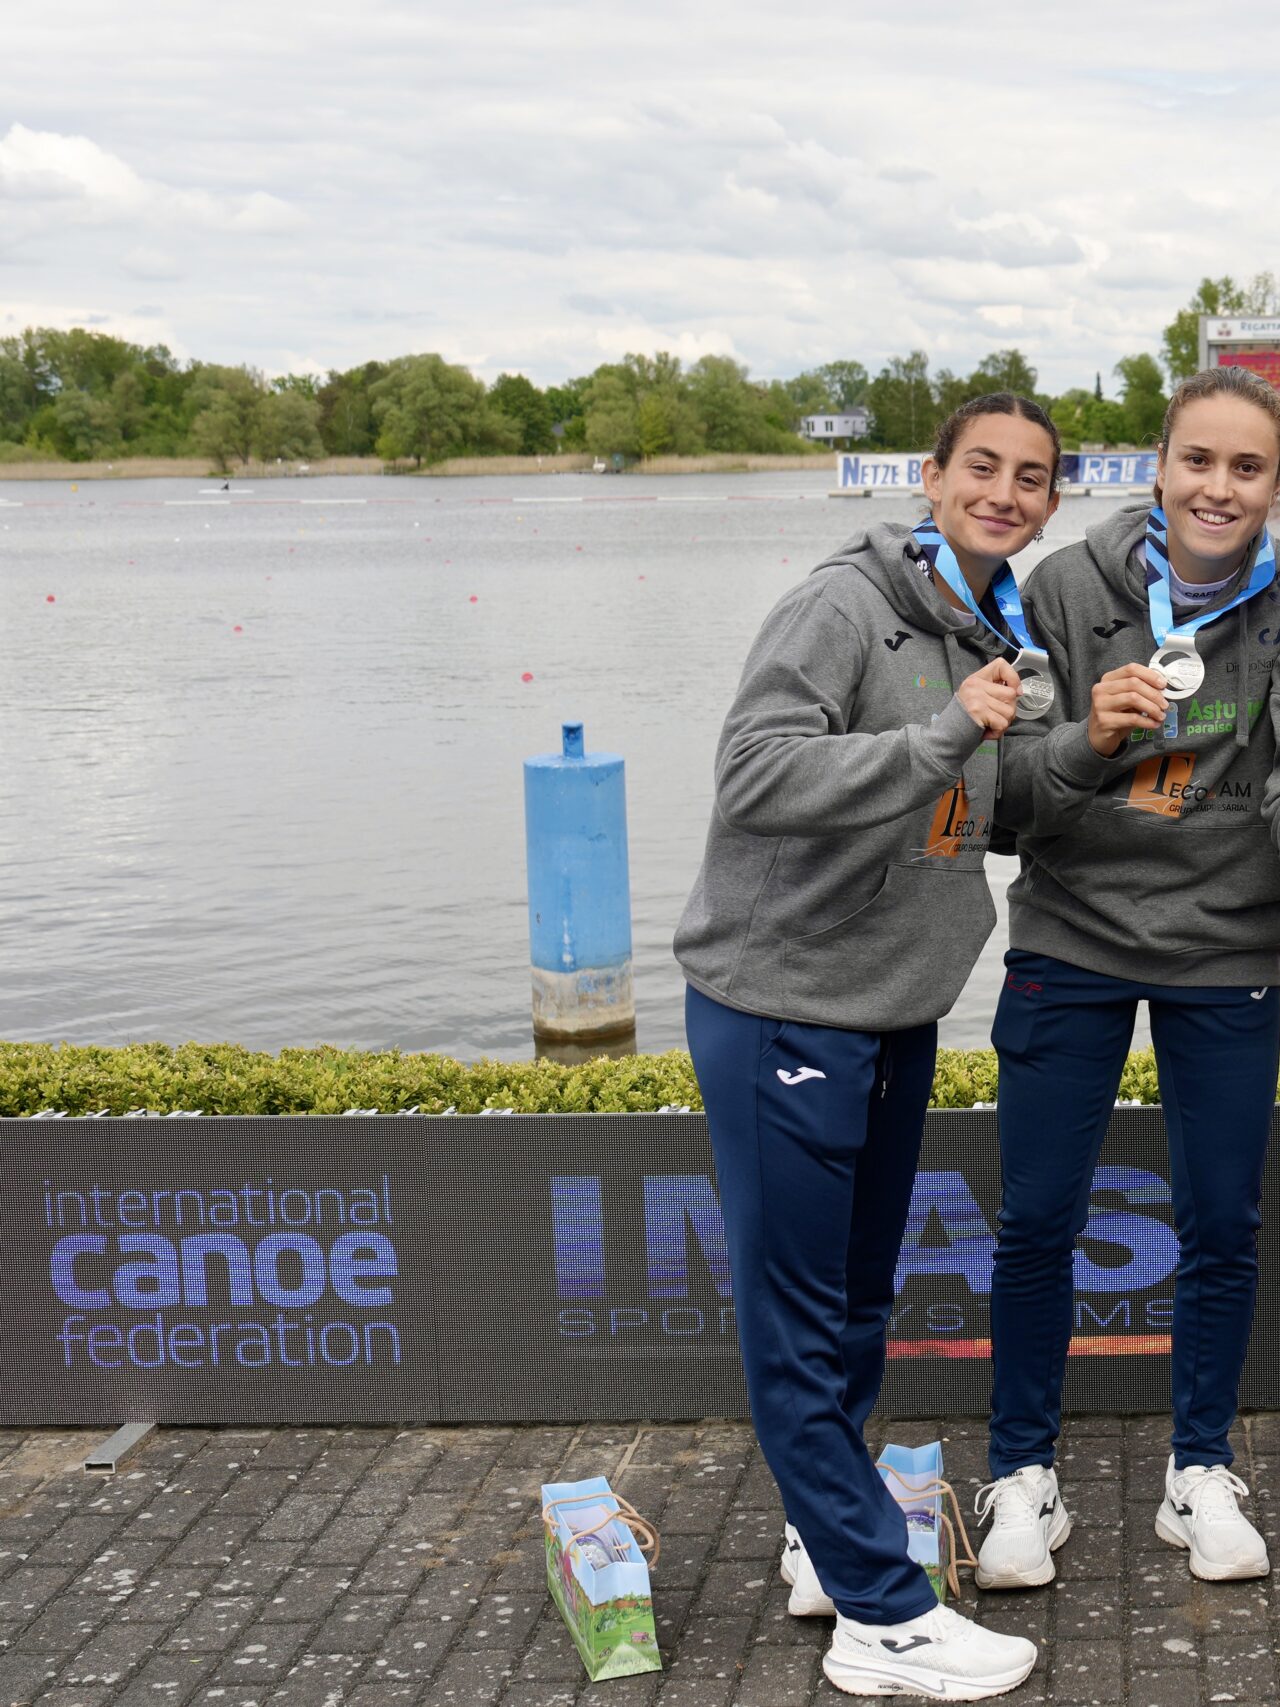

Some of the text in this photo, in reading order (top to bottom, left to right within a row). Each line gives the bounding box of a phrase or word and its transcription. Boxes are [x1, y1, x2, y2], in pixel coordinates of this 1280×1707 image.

[907, 459, 922, 485] B
[43, 1174, 394, 1227] international
[50, 1231, 398, 1310] canoe
[56, 1313, 400, 1368] federation
[558, 1307, 735, 1336] SPO
